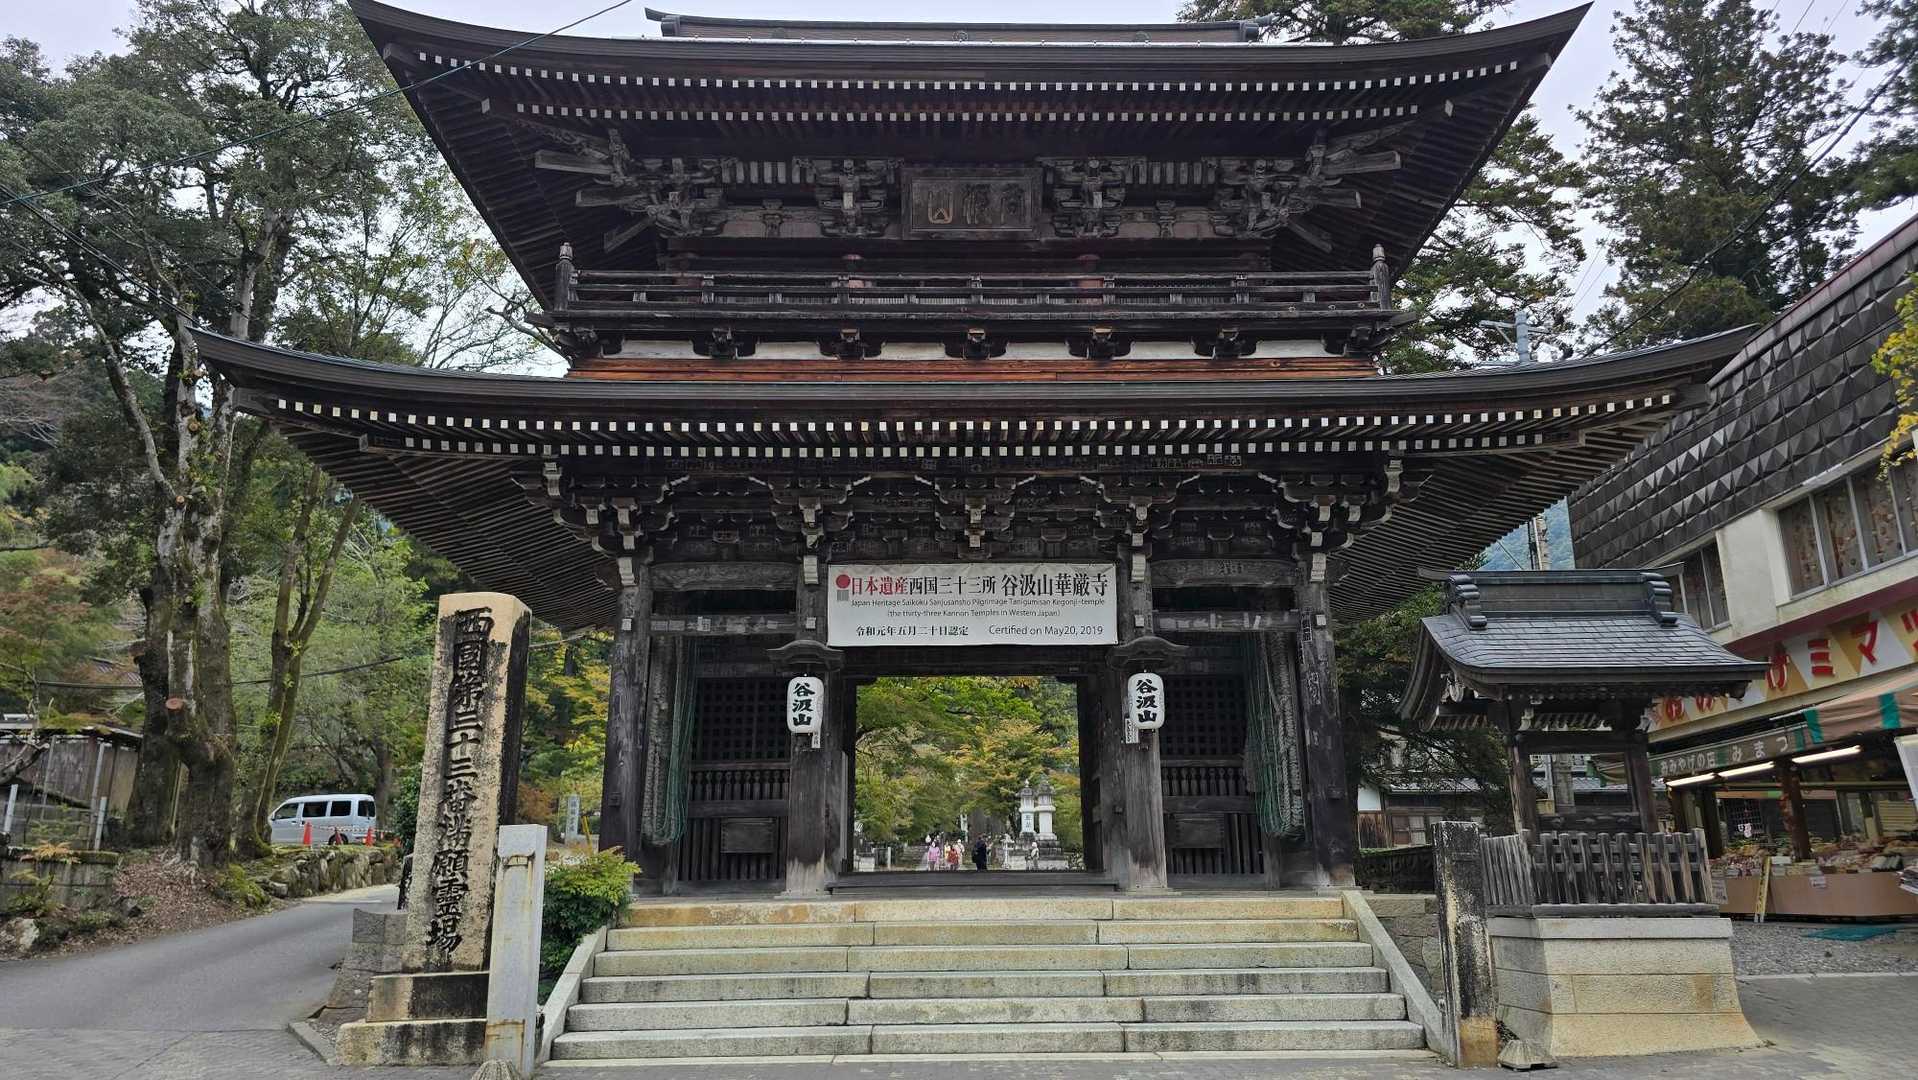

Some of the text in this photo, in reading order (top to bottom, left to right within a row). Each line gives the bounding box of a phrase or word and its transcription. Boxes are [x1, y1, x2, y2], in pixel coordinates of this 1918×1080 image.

[851, 573, 1108, 597] 日本遺産西国三十三所 谷汲山華厳寺
[851, 599, 870, 607] Japan
[872, 599, 901, 607] Heritage
[929, 599, 971, 607] Sanjusansho
[972, 598, 1007, 607] Pilgrimage
[1009, 598, 1051, 607] Tanigumisan
[970, 609, 1000, 617] Temples
[855, 625, 969, 636] 令和元年五月二十日認定
[988, 624, 1103, 637] Certified on May20, 2019
[792, 683, 816, 726] 谷汲山
[1136, 679, 1158, 722] 谷汲山
[1660, 736, 1789, 775] おみやげの店 みまつ
